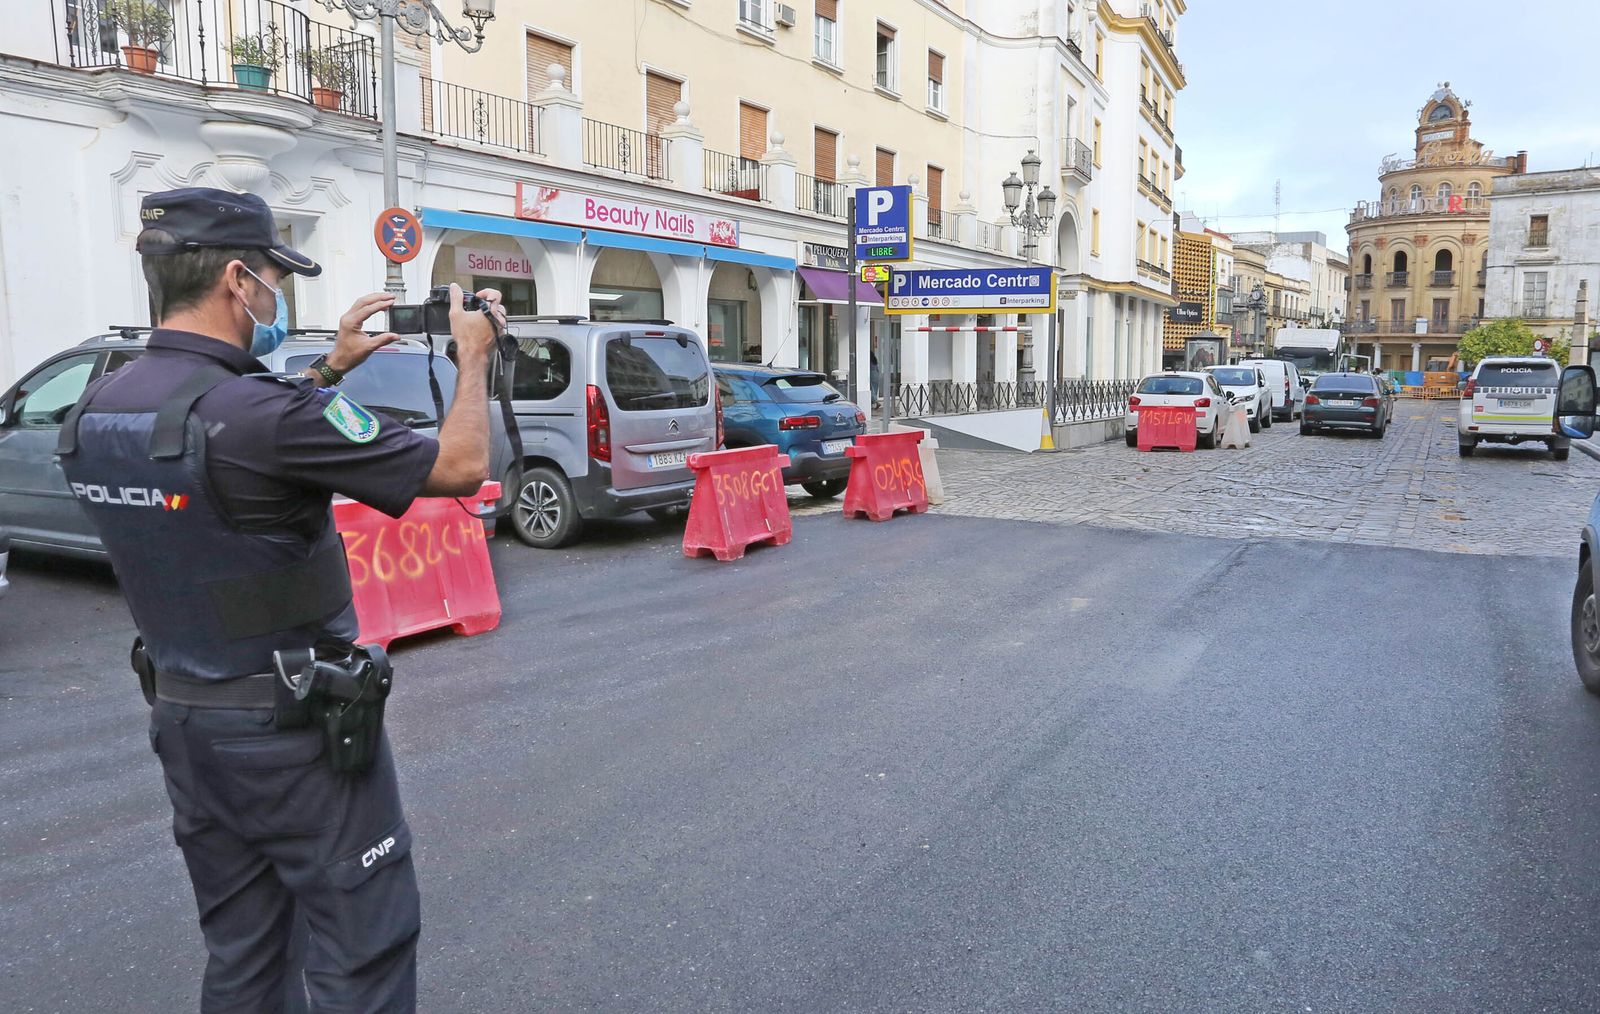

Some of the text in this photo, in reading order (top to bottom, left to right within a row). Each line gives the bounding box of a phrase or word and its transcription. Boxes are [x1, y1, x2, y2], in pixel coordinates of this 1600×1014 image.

[585, 198, 695, 234] Beauty Nails
[868, 190, 894, 226] P
[858, 226, 884, 234] Mercado
[867, 234, 903, 243] Interparking
[871, 247, 893, 256] LIBRE
[468, 253, 502, 271] Salón
[504, 258, 519, 273] de
[893, 273, 907, 294] P
[918, 275, 982, 290] Mercado
[1007, 296, 1045, 305] Interparking
[654, 453, 673, 466] 1883
[70, 482, 168, 506] POLICIA
[712, 466, 778, 507] 3508GCT
[361, 837, 396, 868] CNP
